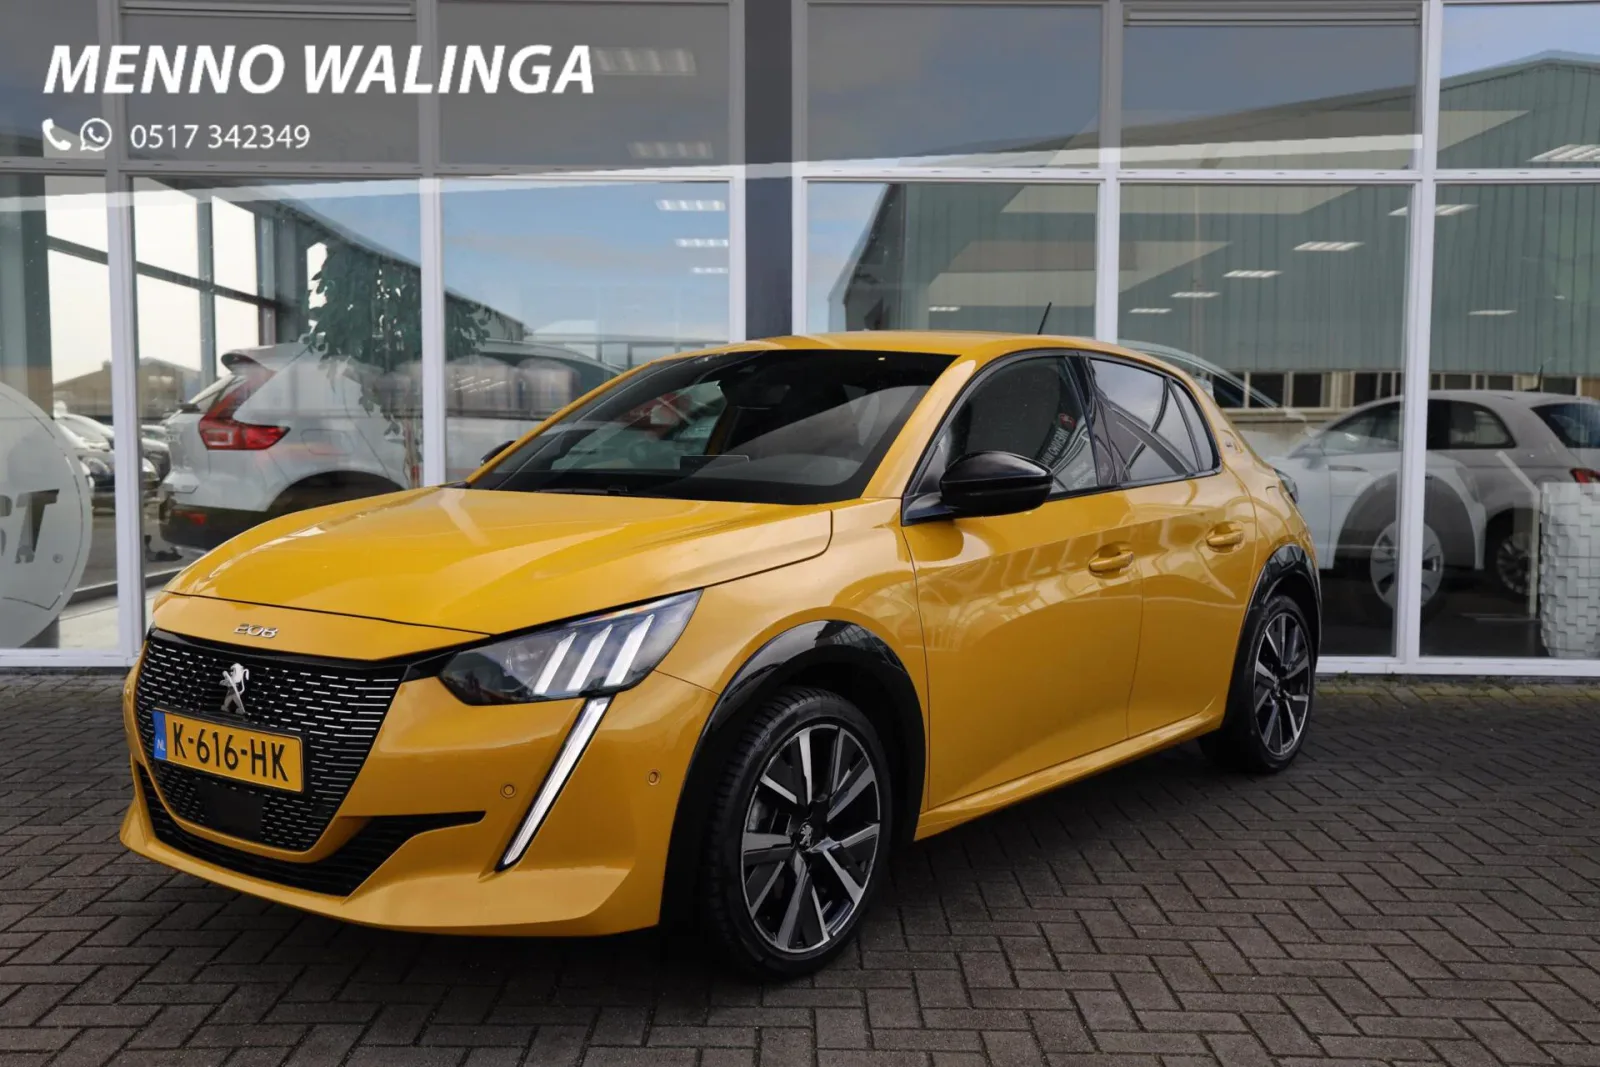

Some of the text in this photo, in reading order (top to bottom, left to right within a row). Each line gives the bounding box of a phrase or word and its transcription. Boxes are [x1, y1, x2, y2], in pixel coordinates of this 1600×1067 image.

[233, 622, 279, 639] 208
[157, 738, 166, 751] NL
[173, 721, 289, 782] K-616-HK
